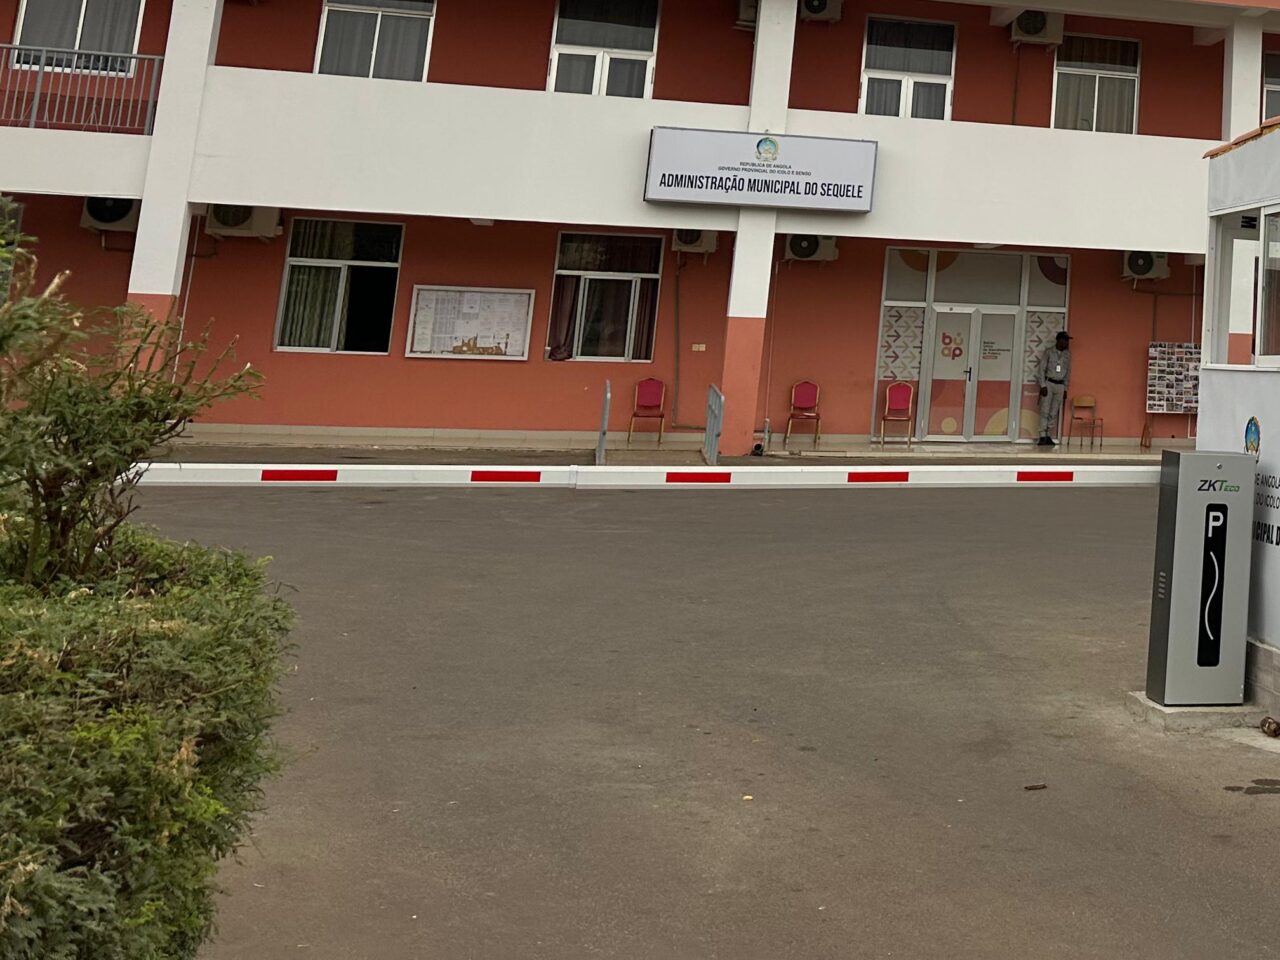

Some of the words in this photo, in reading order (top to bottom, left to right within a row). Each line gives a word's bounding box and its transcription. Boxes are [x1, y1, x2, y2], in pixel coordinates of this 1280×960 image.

[659, 173, 745, 194] ADMINISTRAÇÃO
[747, 178, 801, 196] MUNICIPAL
[804, 182, 818, 197] DO
[820, 182, 864, 199] SEQUELE
[1265, 494, 1280, 510] ICOLO
[1207, 511, 1224, 538] P
